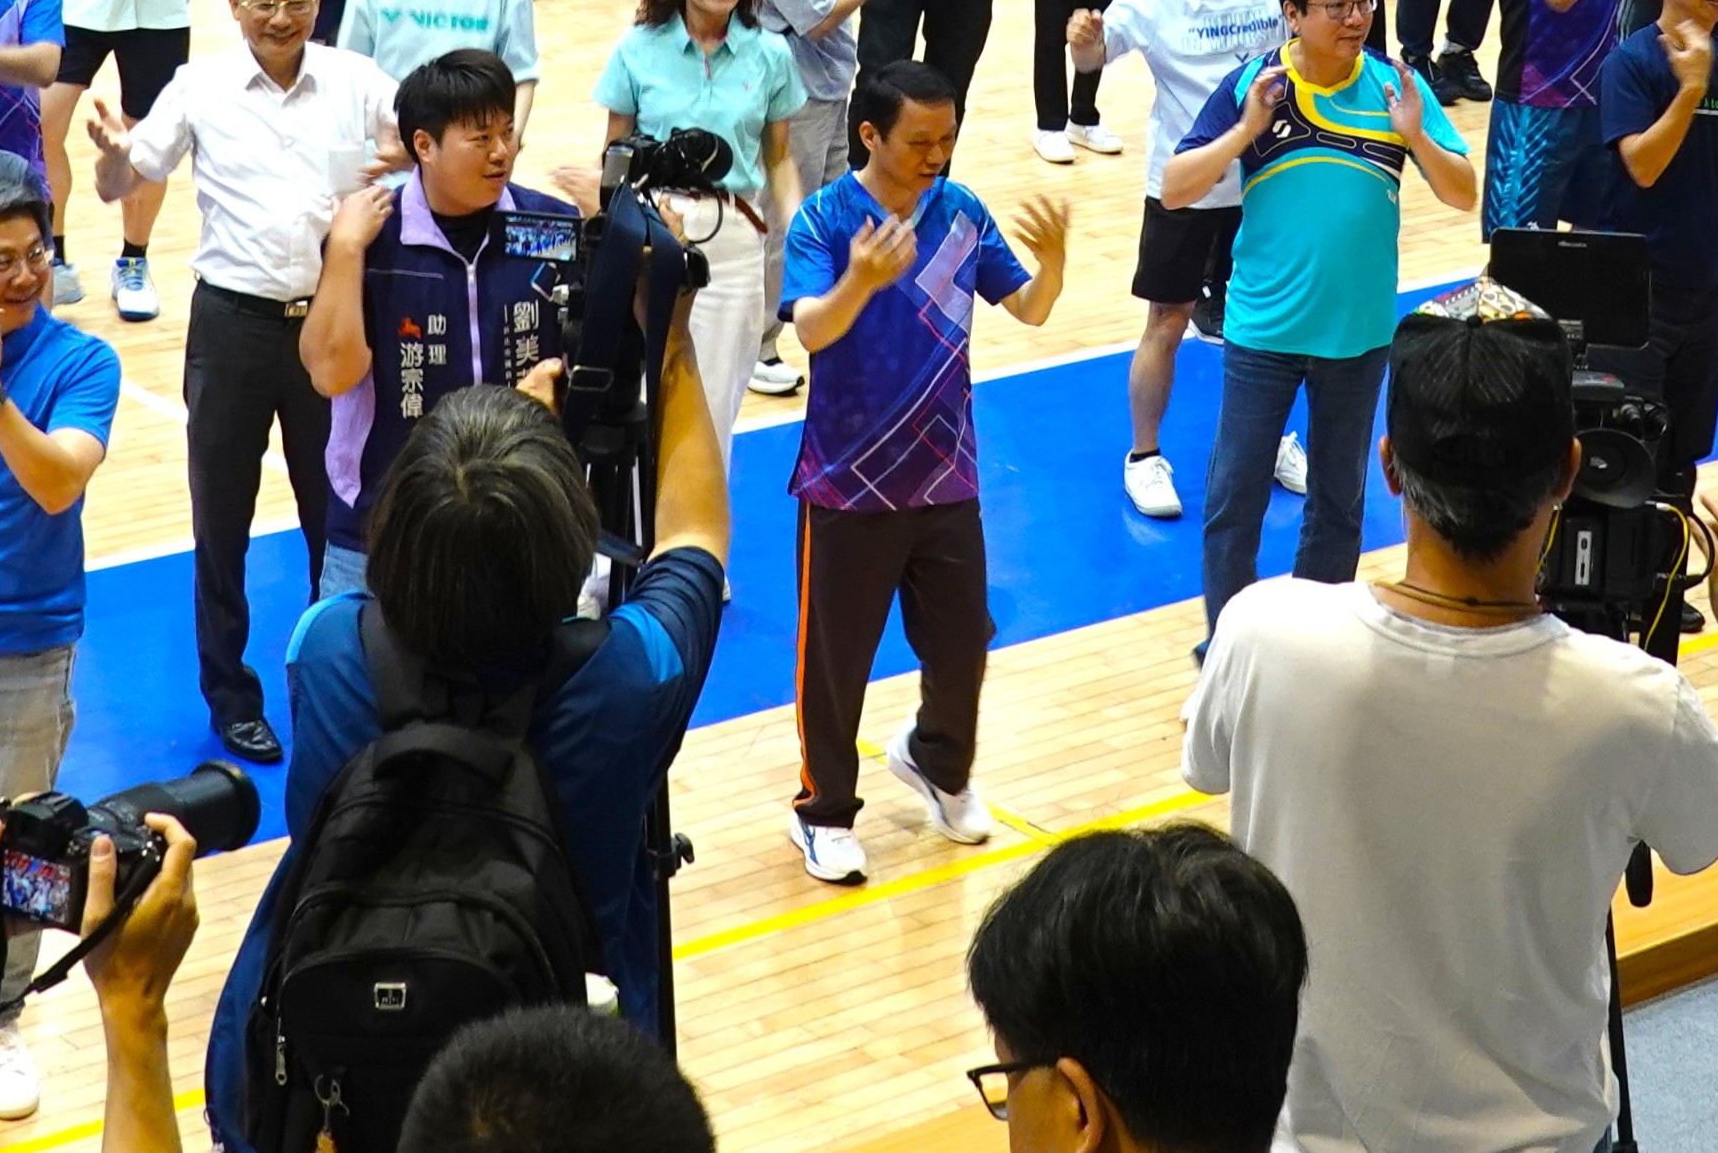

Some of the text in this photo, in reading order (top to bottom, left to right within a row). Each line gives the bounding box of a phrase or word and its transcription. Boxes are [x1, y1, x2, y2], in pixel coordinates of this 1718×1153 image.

[410, 12, 488, 31] VICTOR
[428, 314, 446, 365] 助理
[400, 342, 424, 419] 游宗偉
